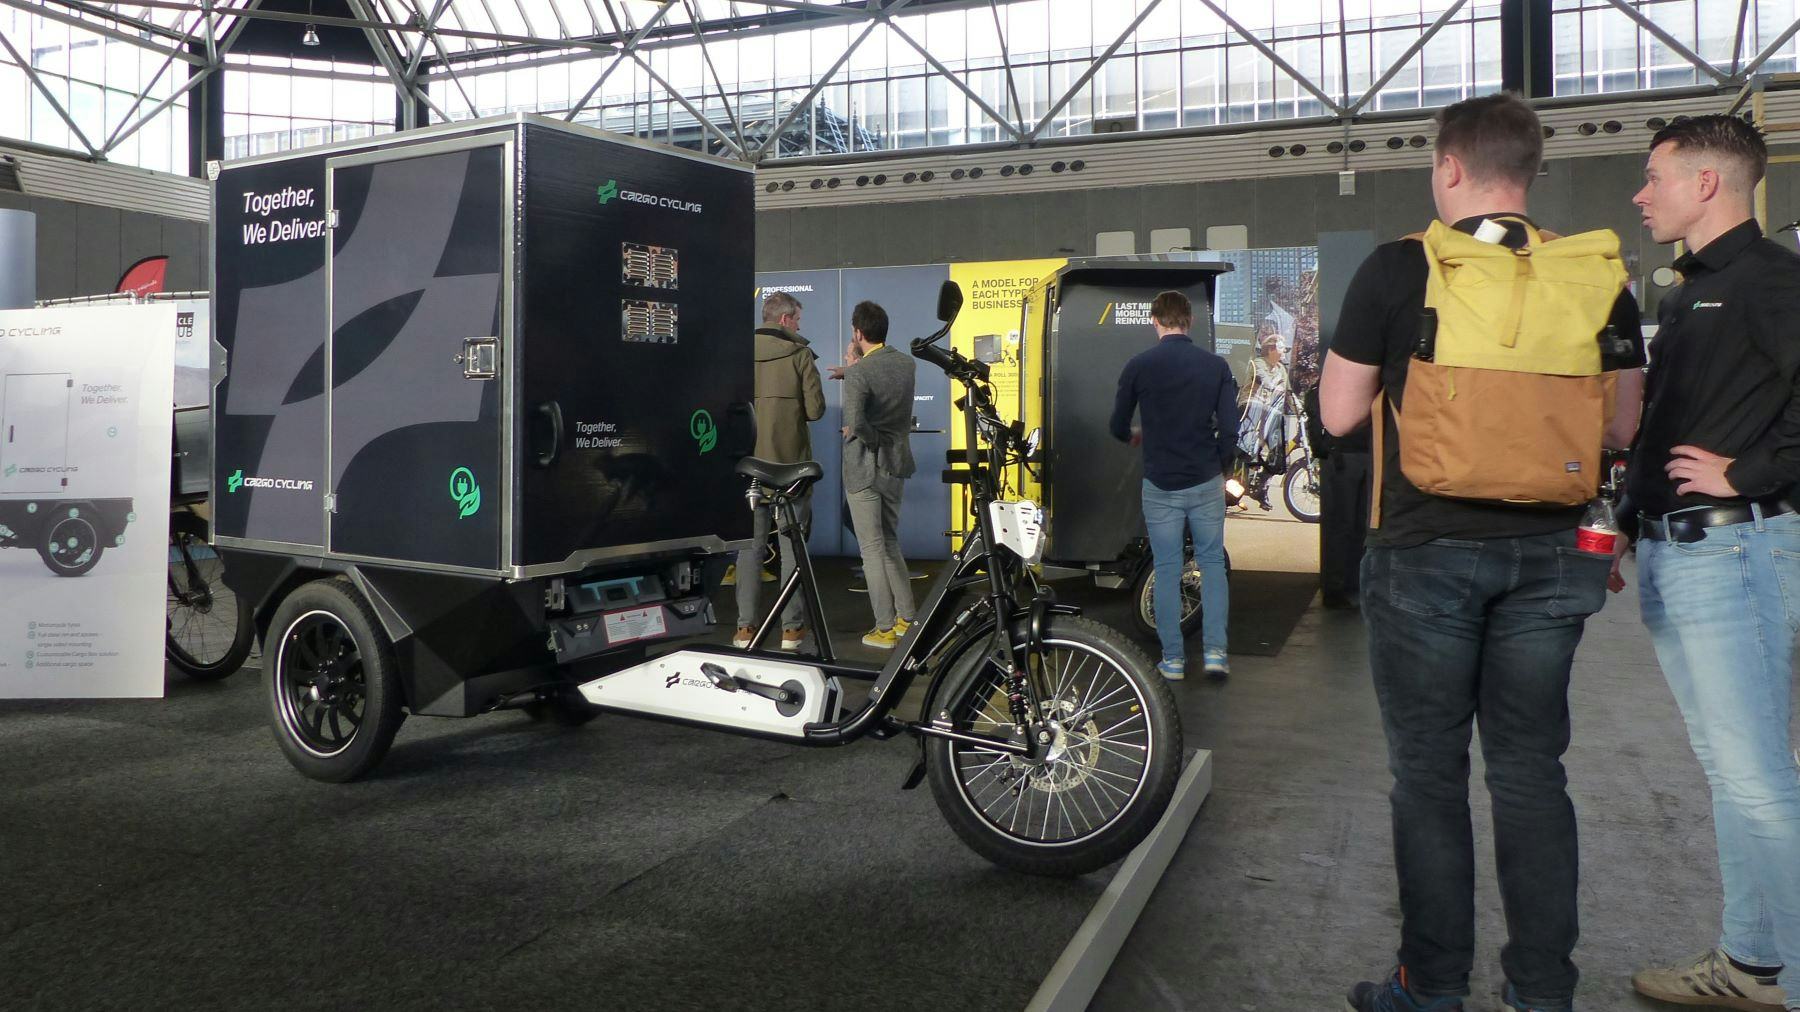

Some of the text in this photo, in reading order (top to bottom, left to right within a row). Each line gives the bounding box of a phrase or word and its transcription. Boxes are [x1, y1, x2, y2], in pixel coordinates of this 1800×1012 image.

[243, 186, 315, 216] Together,
[243, 218, 326, 245] We Deliver.
[972, 280, 979, 288] A
[981, 279, 1017, 288] MODEL
[762, 285, 814, 293] PROFESSIONAL
[972, 290, 1000, 299] EACH
[1115, 302, 1137, 310] LAST
[81, 396, 95, 404] We
[576, 421, 617, 435] Together,
[576, 436, 623, 448] We Deliver.
